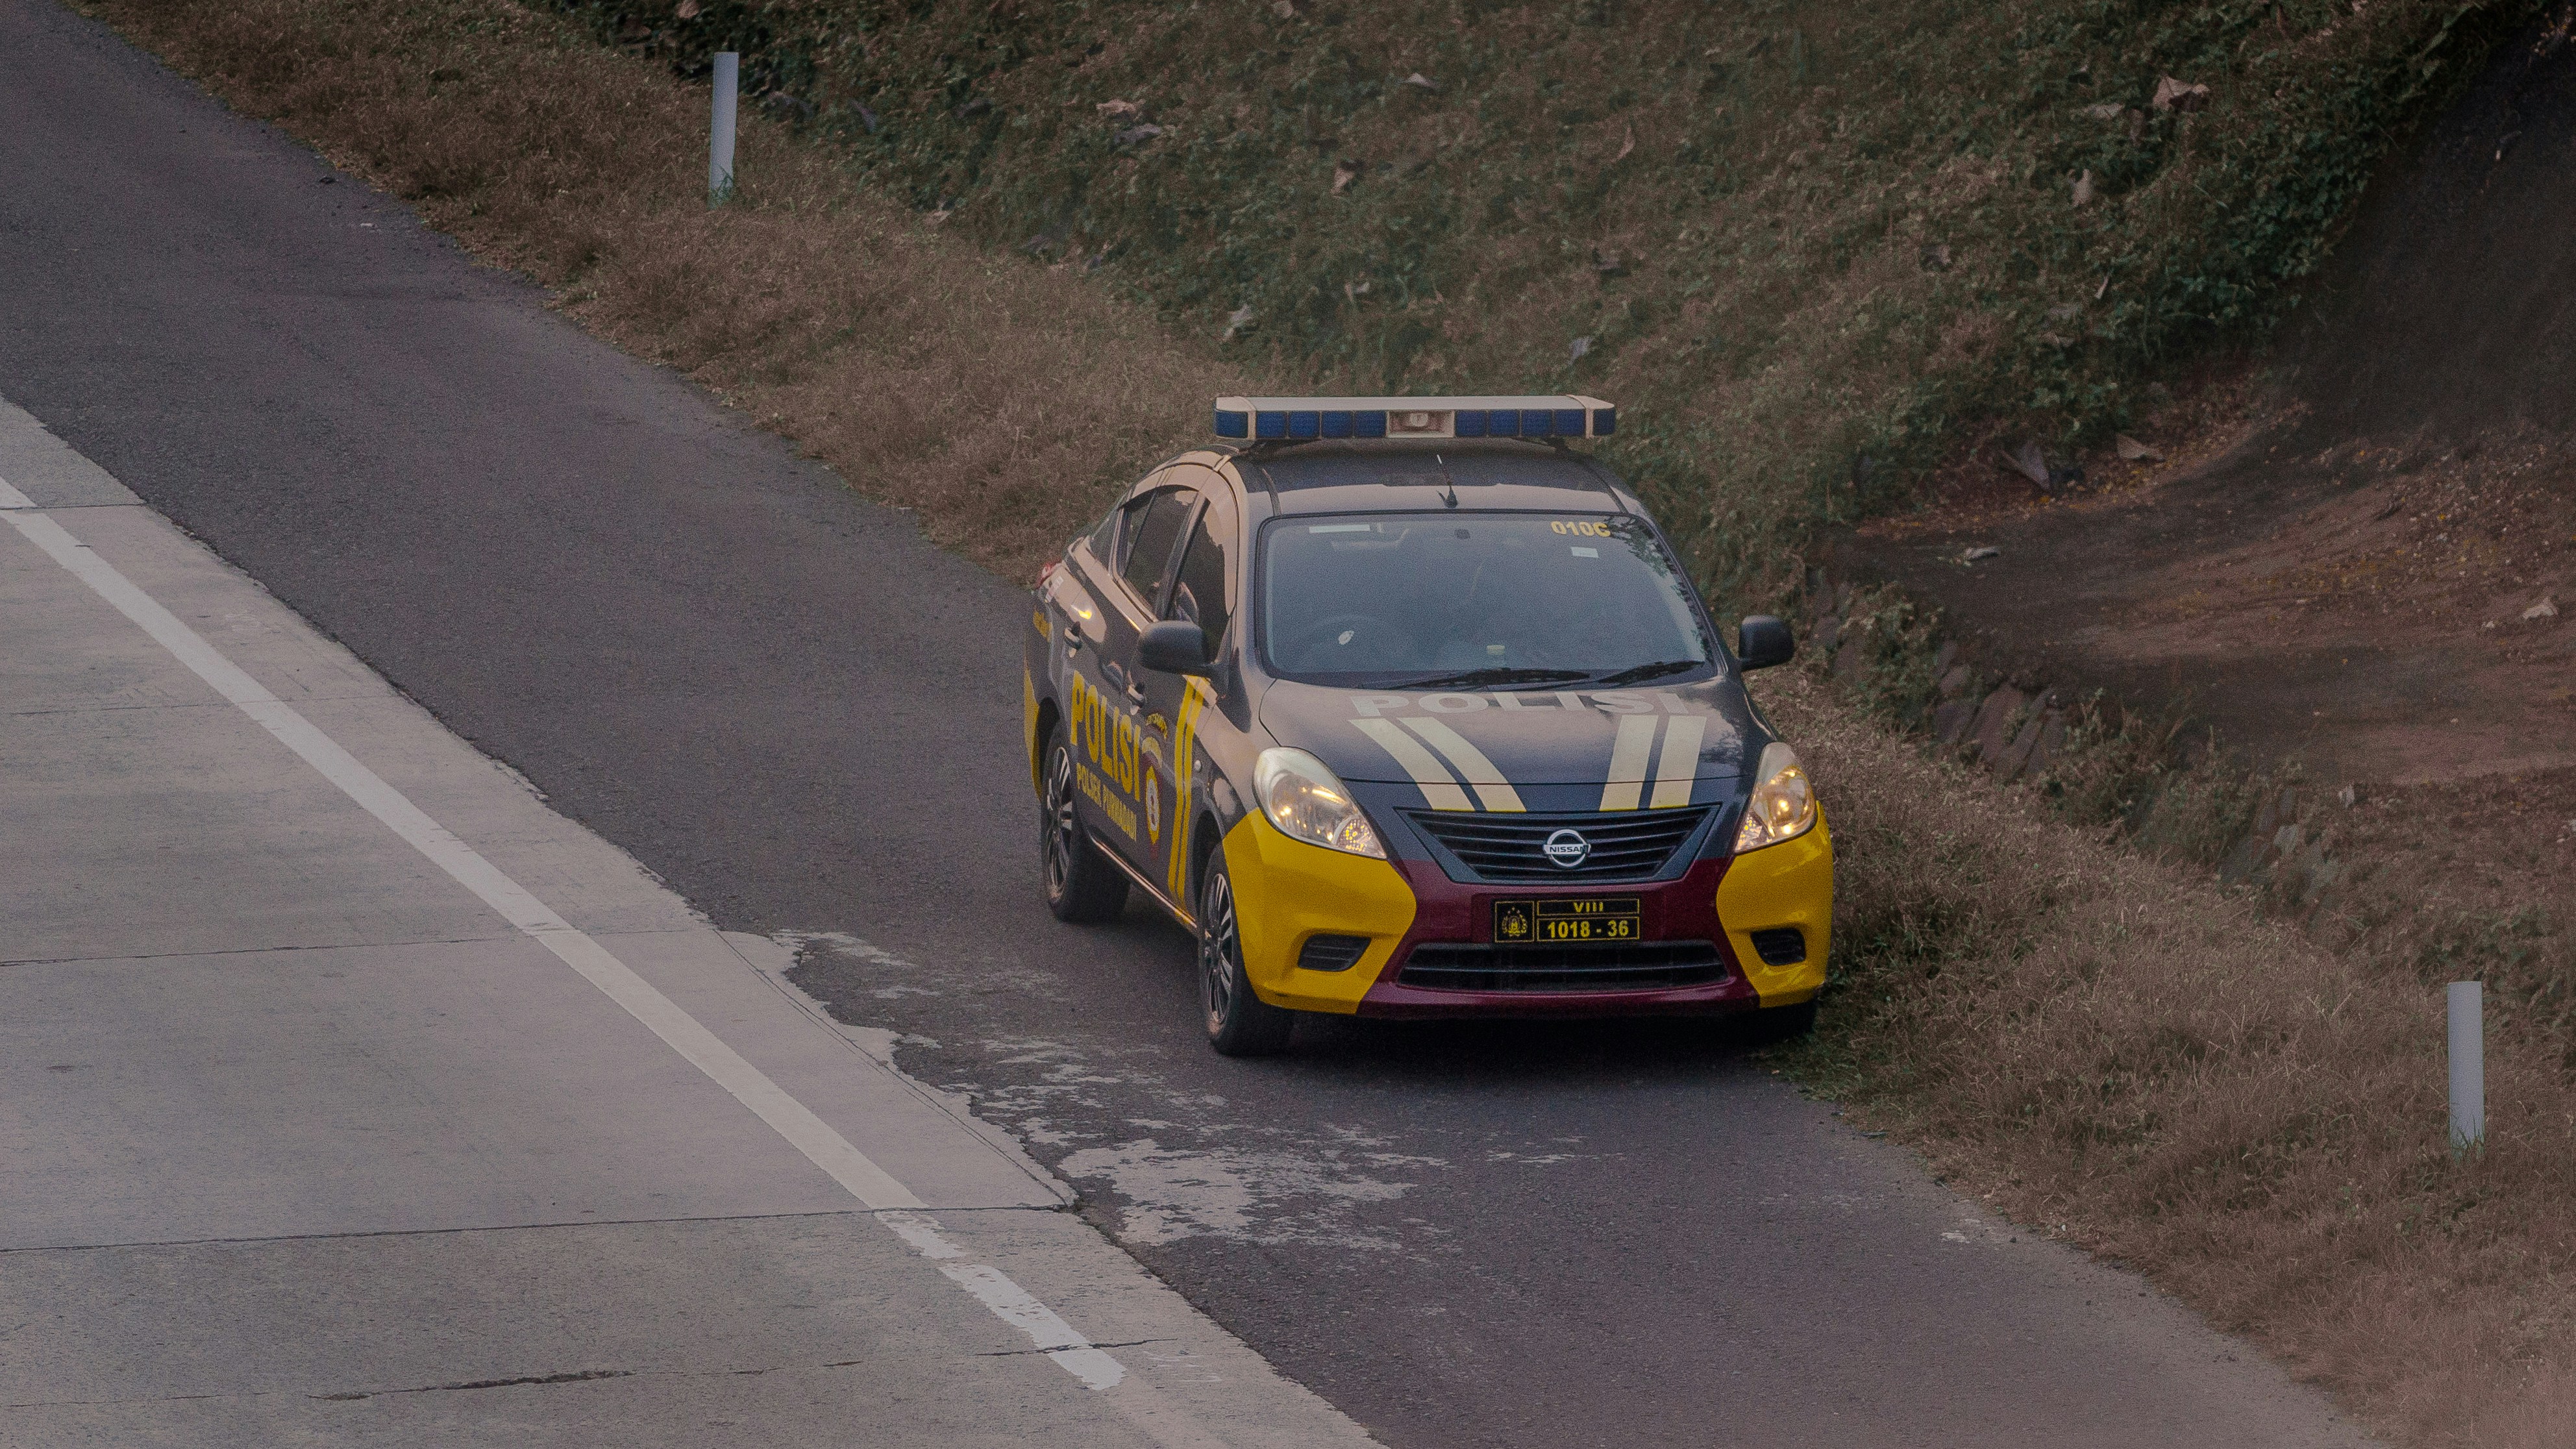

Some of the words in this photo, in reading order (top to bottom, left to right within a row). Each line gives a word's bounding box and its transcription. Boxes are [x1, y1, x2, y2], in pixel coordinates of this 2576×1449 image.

[1350, 691, 1689, 717] POLISI
[1070, 669, 1141, 802] POLISI
[1573, 901, 1604, 913] VIII
[1548, 921, 1590, 938] 1018
[1607, 919, 1629, 937] 36
